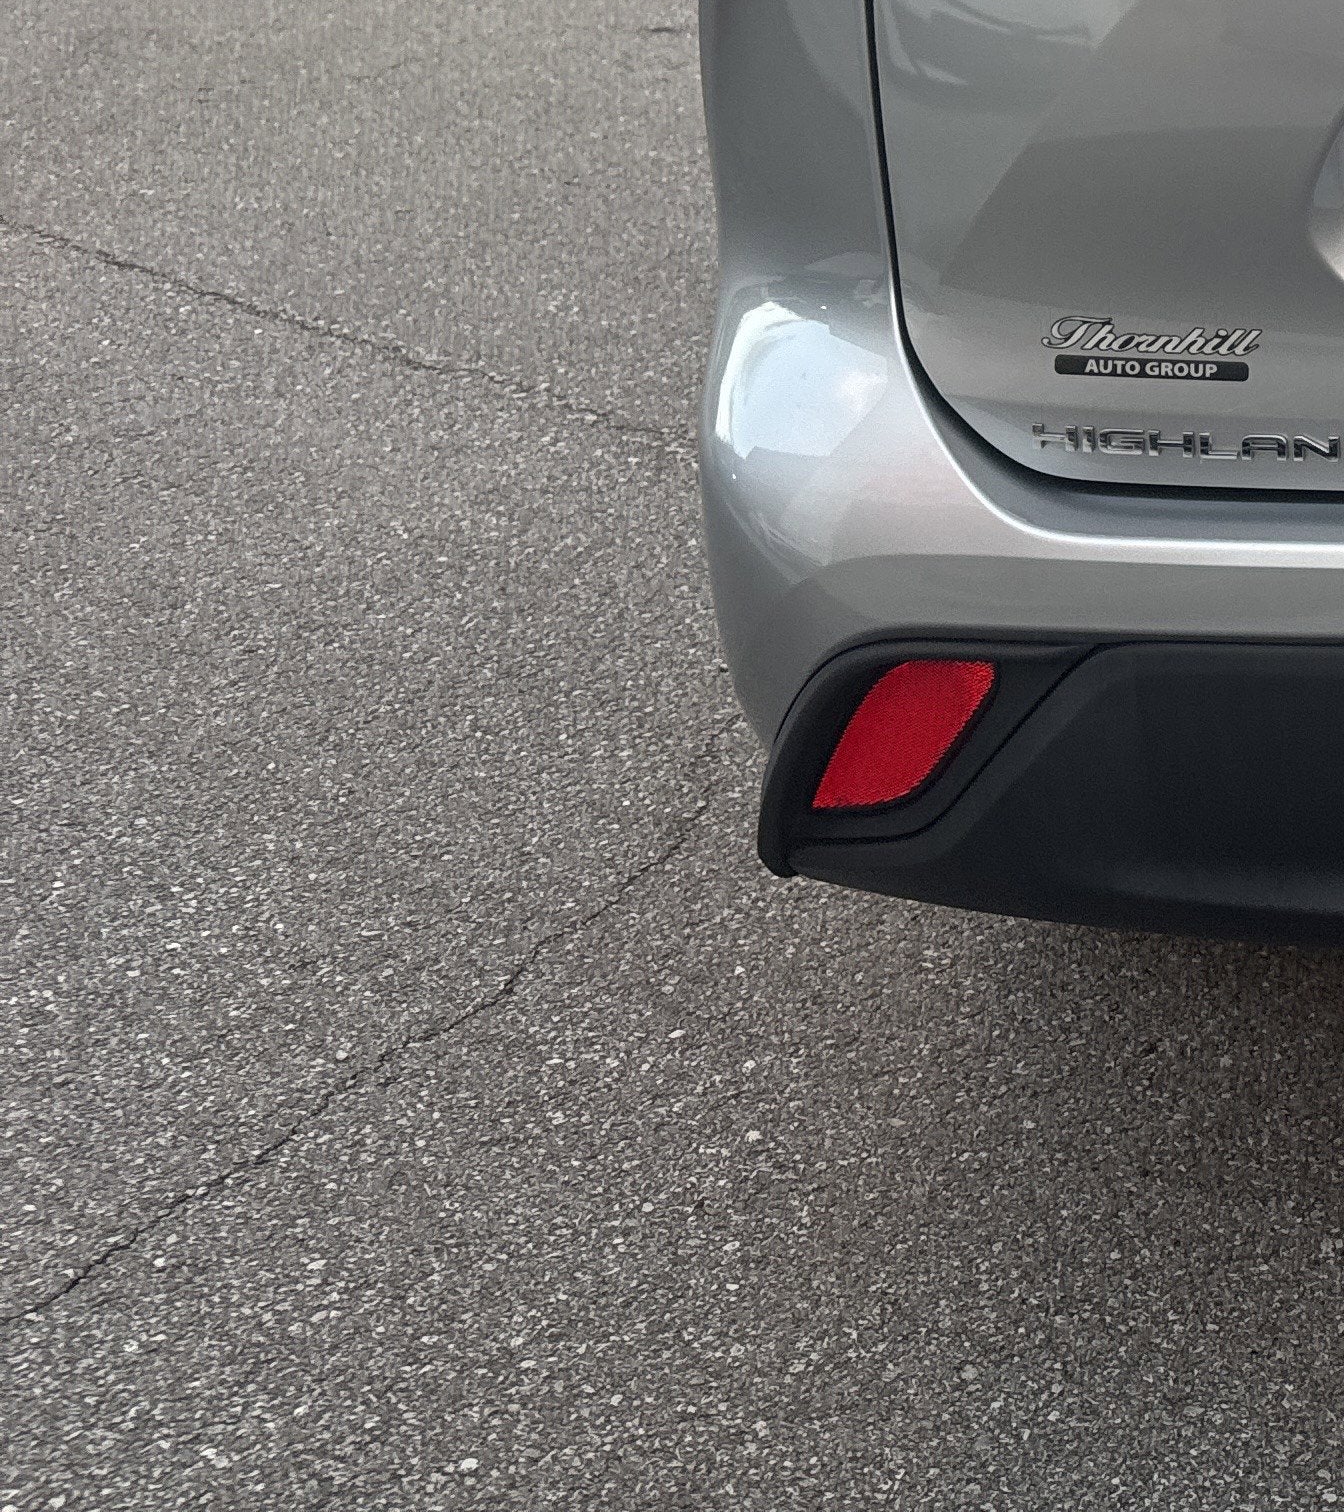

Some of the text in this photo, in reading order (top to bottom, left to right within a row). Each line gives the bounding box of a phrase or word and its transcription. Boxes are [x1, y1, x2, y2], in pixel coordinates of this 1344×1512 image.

[1041, 316, 1262, 356] Thornhill
[1084, 359, 1218, 378] AUTO GROUP
